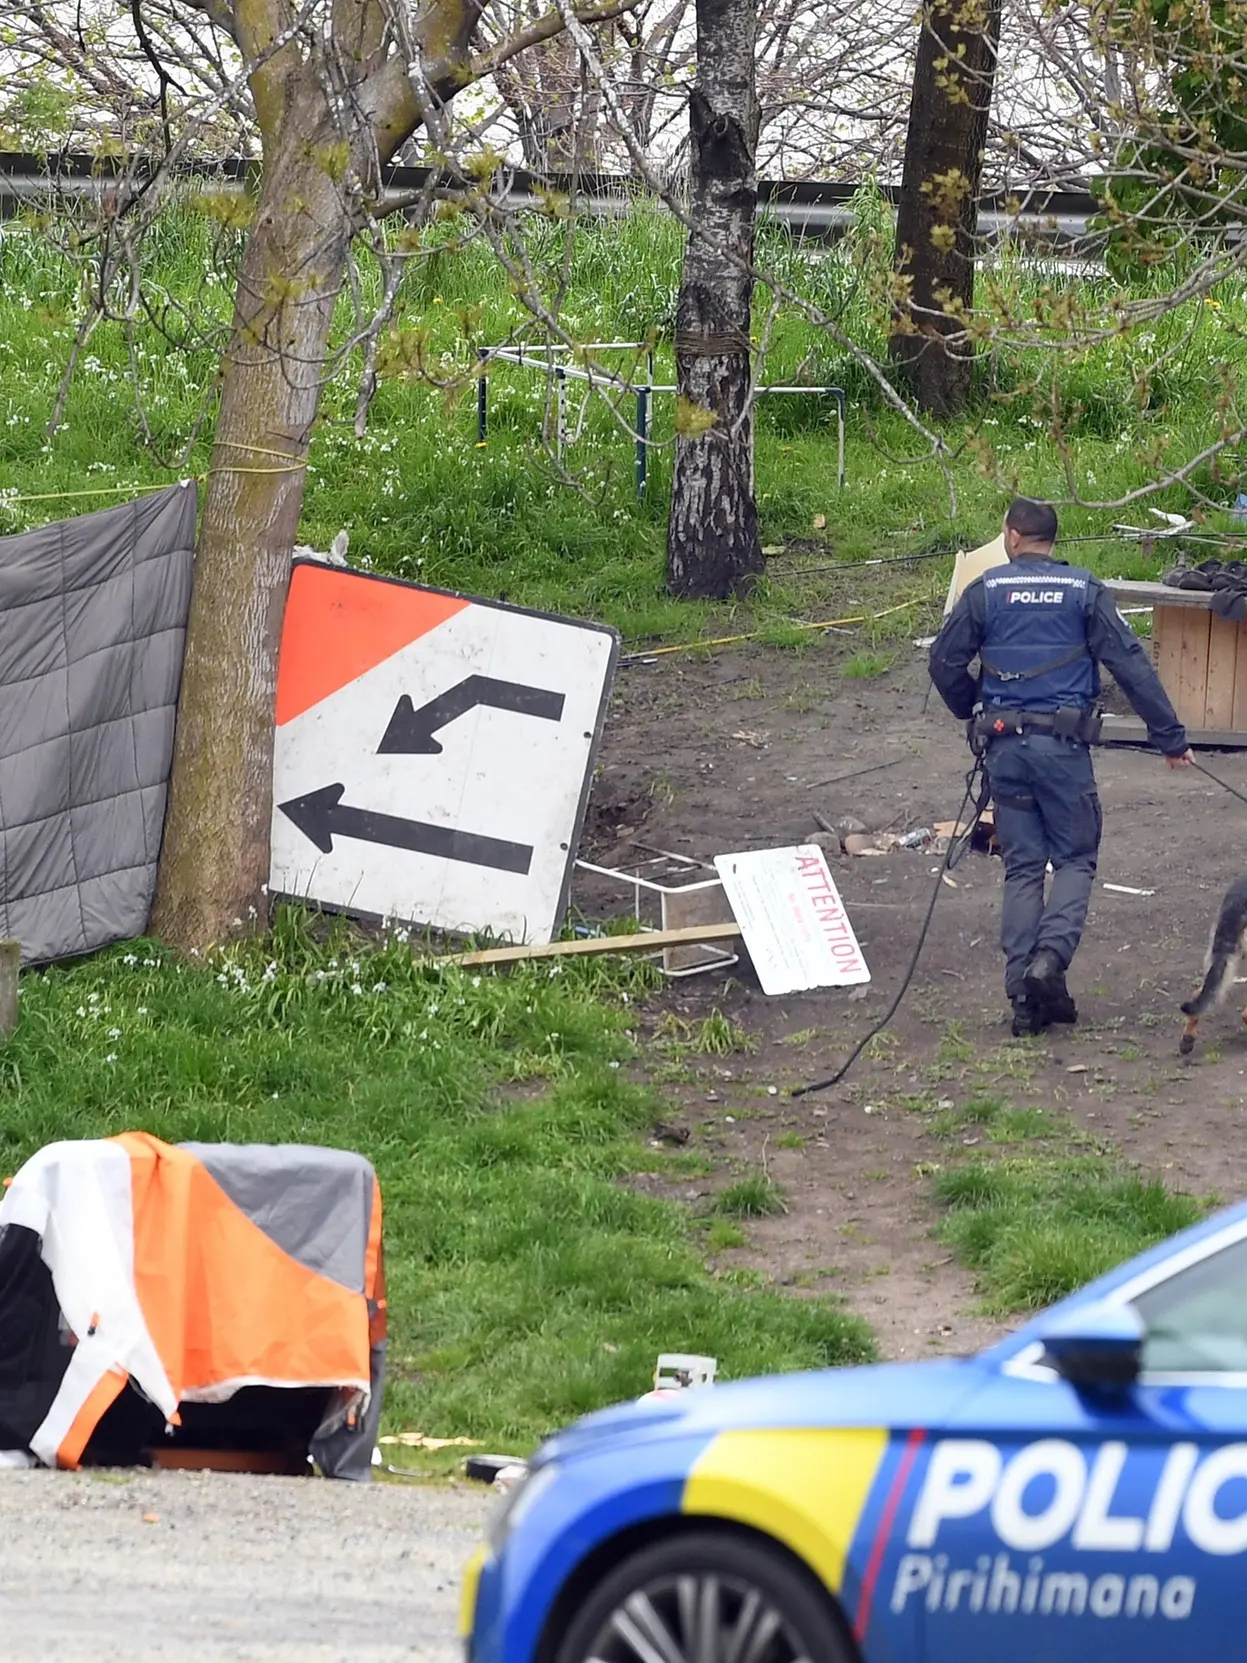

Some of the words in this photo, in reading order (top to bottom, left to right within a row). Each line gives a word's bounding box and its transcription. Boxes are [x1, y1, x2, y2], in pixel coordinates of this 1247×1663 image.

[1010, 591, 1064, 604] POLICE
[795, 857, 862, 973] ATTENTION
[891, 1553, 1197, 1620] Pirihimana
